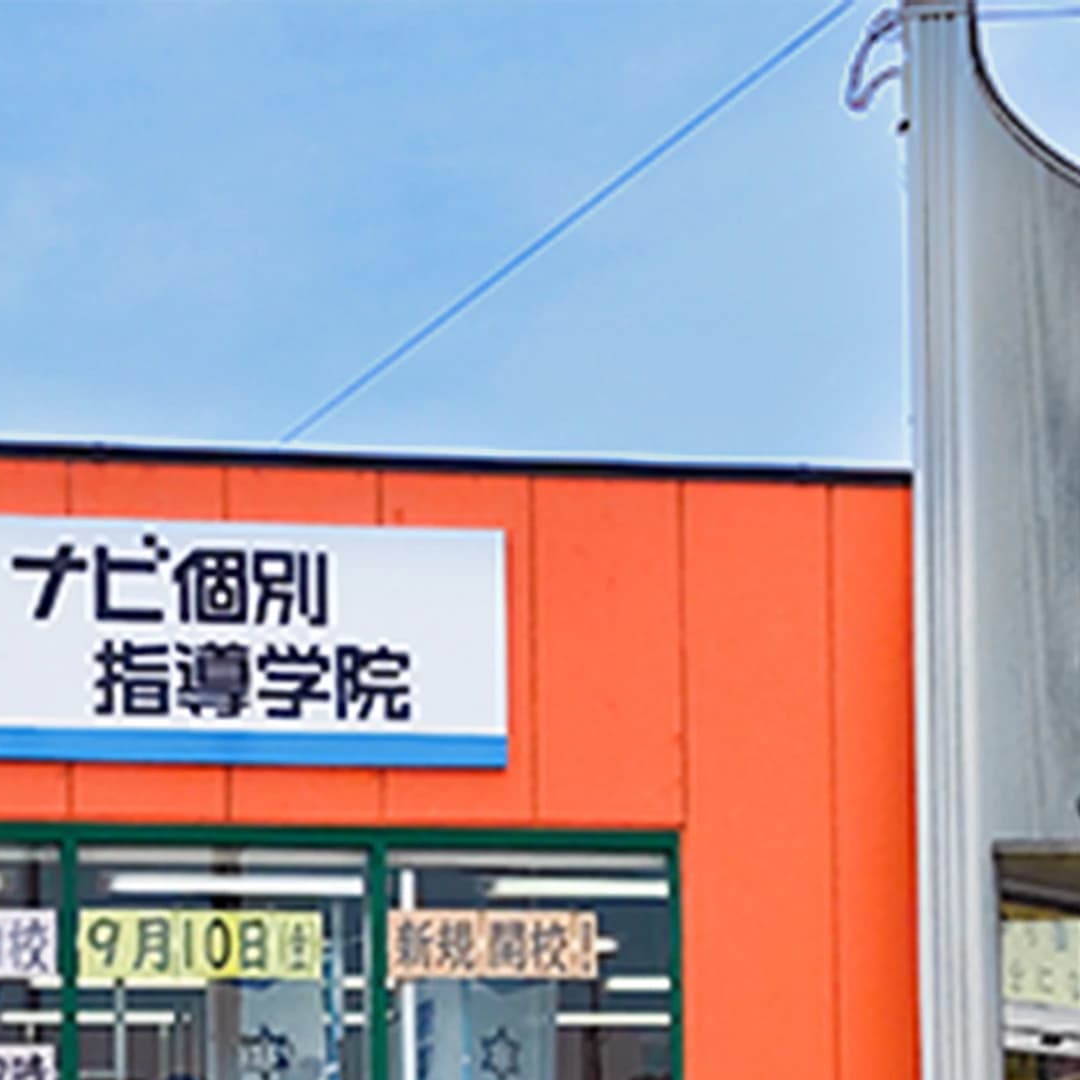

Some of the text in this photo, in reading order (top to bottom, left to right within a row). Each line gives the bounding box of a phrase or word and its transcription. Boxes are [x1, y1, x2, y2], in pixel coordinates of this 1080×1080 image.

[11, 533, 329, 627] ナビ個別
[93, 640, 411, 721] 指導学院
